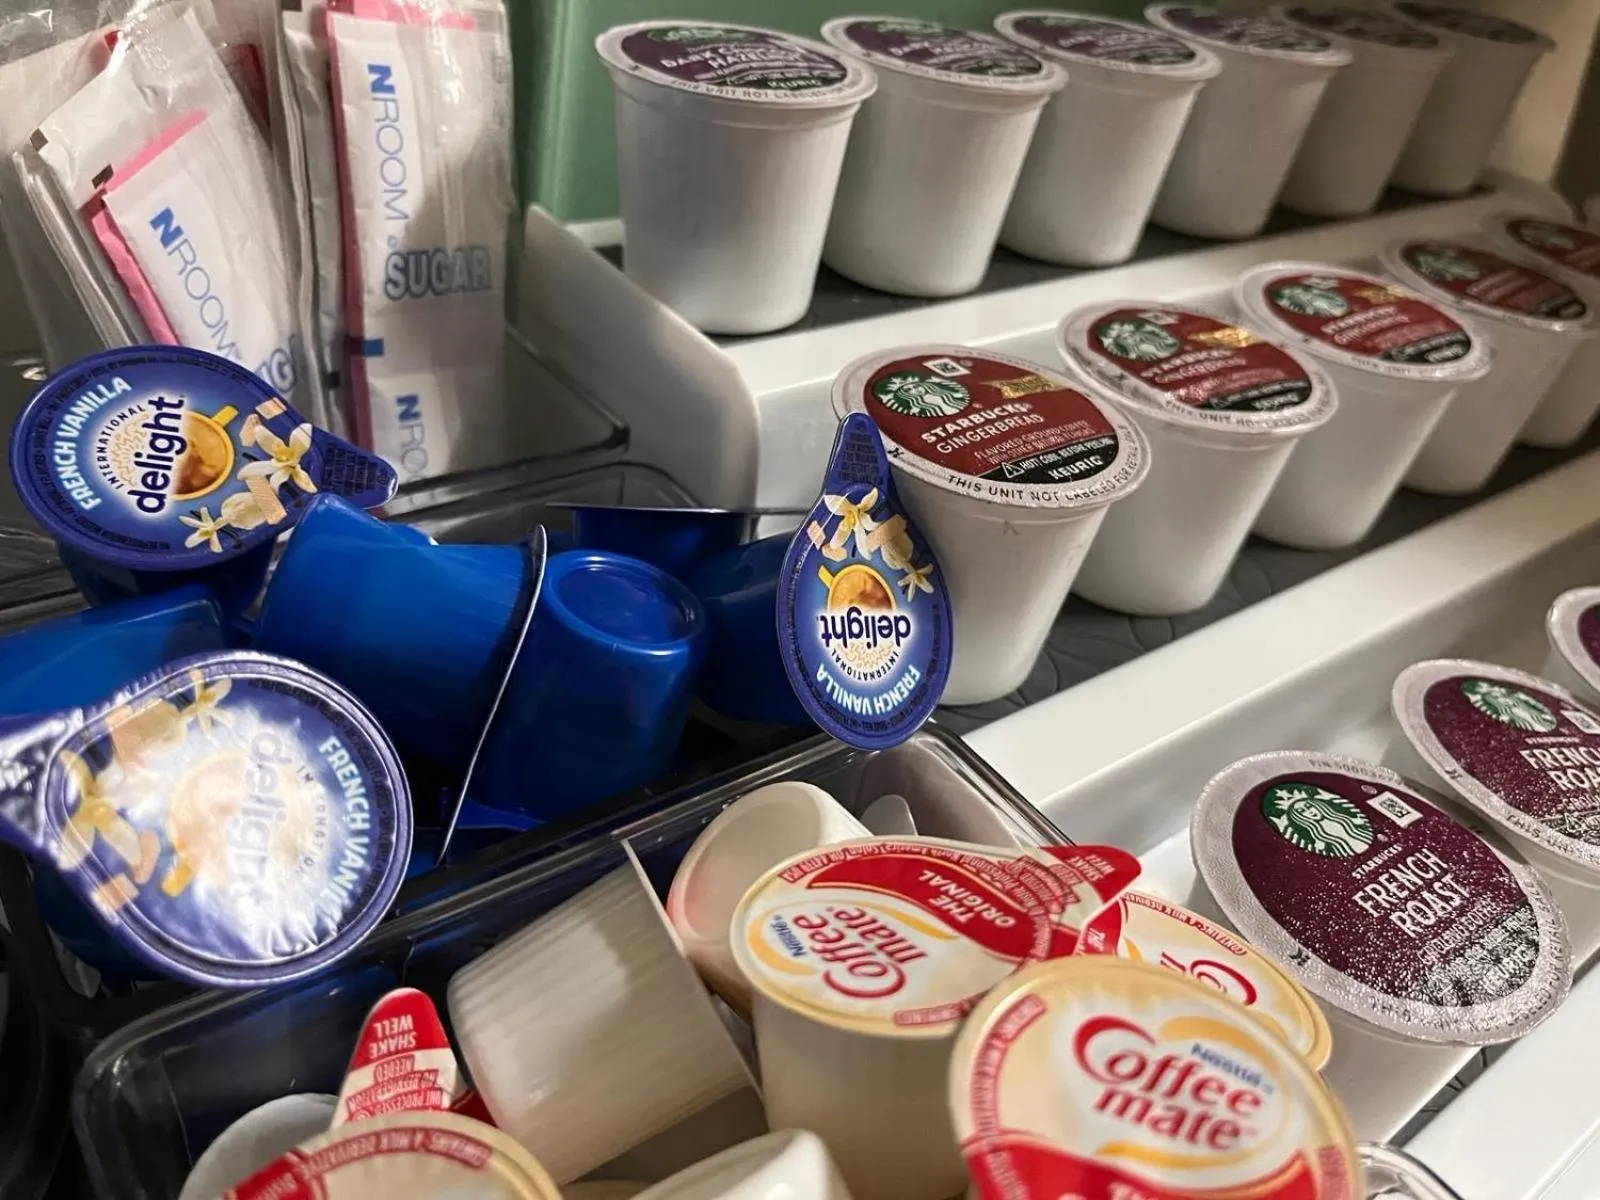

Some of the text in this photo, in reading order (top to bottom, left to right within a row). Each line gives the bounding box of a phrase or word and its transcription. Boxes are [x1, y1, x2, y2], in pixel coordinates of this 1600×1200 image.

[384, 245, 491, 301] SUGAR
[56, 376, 132, 438] VANILLA
[921, 403, 1029, 445] STARBUCKS
[96, 405, 147, 490] INTERNATIONAL
[127, 396, 188, 513] delight
[936, 413, 1045, 455] GINGERBREAD
[974, 437, 1023, 460] FLAVORED
[54, 440, 102, 510] FRENCH
[948, 474, 982, 493] THIS
[988, 486, 1024, 501] UNIT
[1030, 490, 1060, 503] NOT
[1048, 454, 1104, 480] KEURIG
[819, 606, 912, 650] delight
[831, 648, 900, 682] INTERNATIONAL
[816, 663, 921, 716] FRENCH VANILLA
[1548, 767, 1600, 791] ROA
[315, 735, 371, 922] FRENCH VANIL
[1065, 855, 1105, 882] SHAKE
[1084, 853, 1117, 876] WELL
[1352, 844, 1402, 880] STARBUCKS
[1352, 847, 1450, 917] FRENCH
[917, 868, 1017, 928] ORIGINAL
[928, 893, 976, 924] THE
[1389, 874, 1471, 938] ROAST
[770, 917, 808, 959] Nestlé
[792, 913, 907, 999] Coffee
[833, 906, 928, 965] mate
[368, 1031, 418, 1060] SHAKE
[373, 1014, 414, 1039] WELL
[375, 1056, 415, 1084] NEEDED
[1072, 1014, 1263, 1118] Coffee
[1191, 1042, 1262, 1088] Nestlé
[1093, 1086, 1242, 1151] mate
